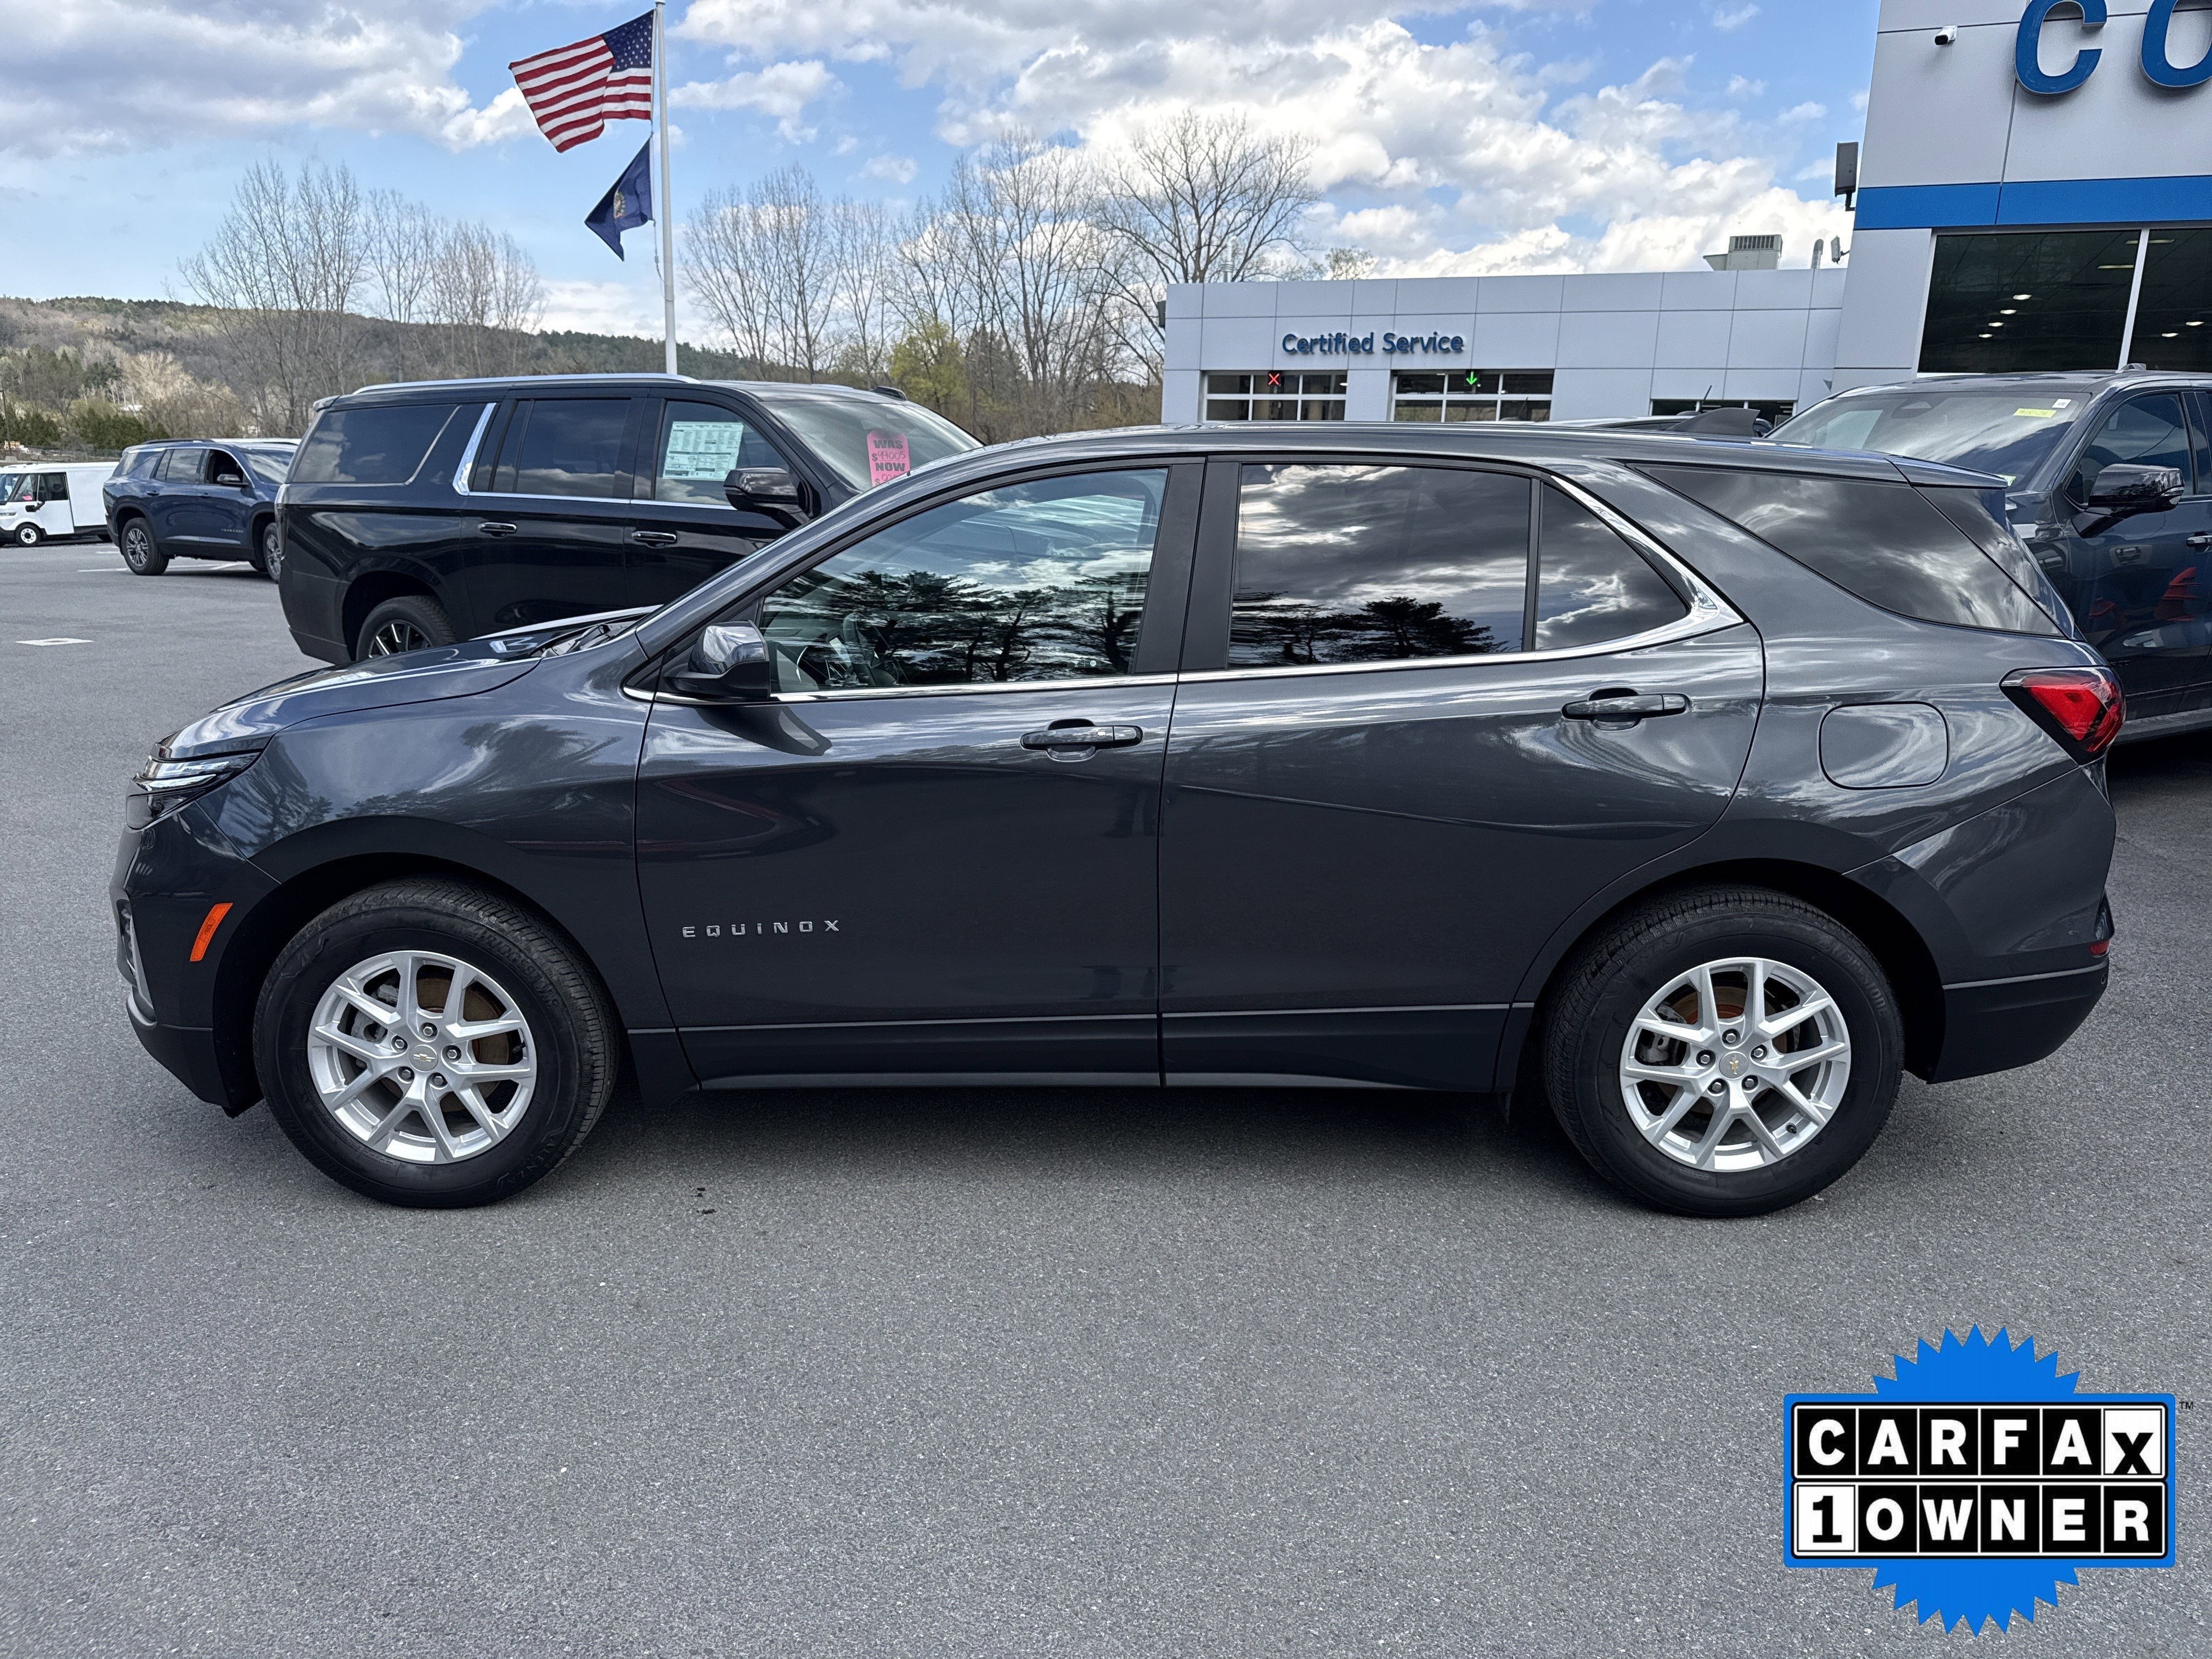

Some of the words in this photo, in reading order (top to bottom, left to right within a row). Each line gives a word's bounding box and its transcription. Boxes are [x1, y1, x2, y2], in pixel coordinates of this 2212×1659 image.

[1282, 332, 1374, 354] Certified
[1382, 331, 1464, 353] Service
[873, 440, 903, 449] WAS
[876, 462, 905, 471] NOW
[682, 920, 839, 938] EQUINOX
[474, 926, 560, 1009] BRIDGESTONE
